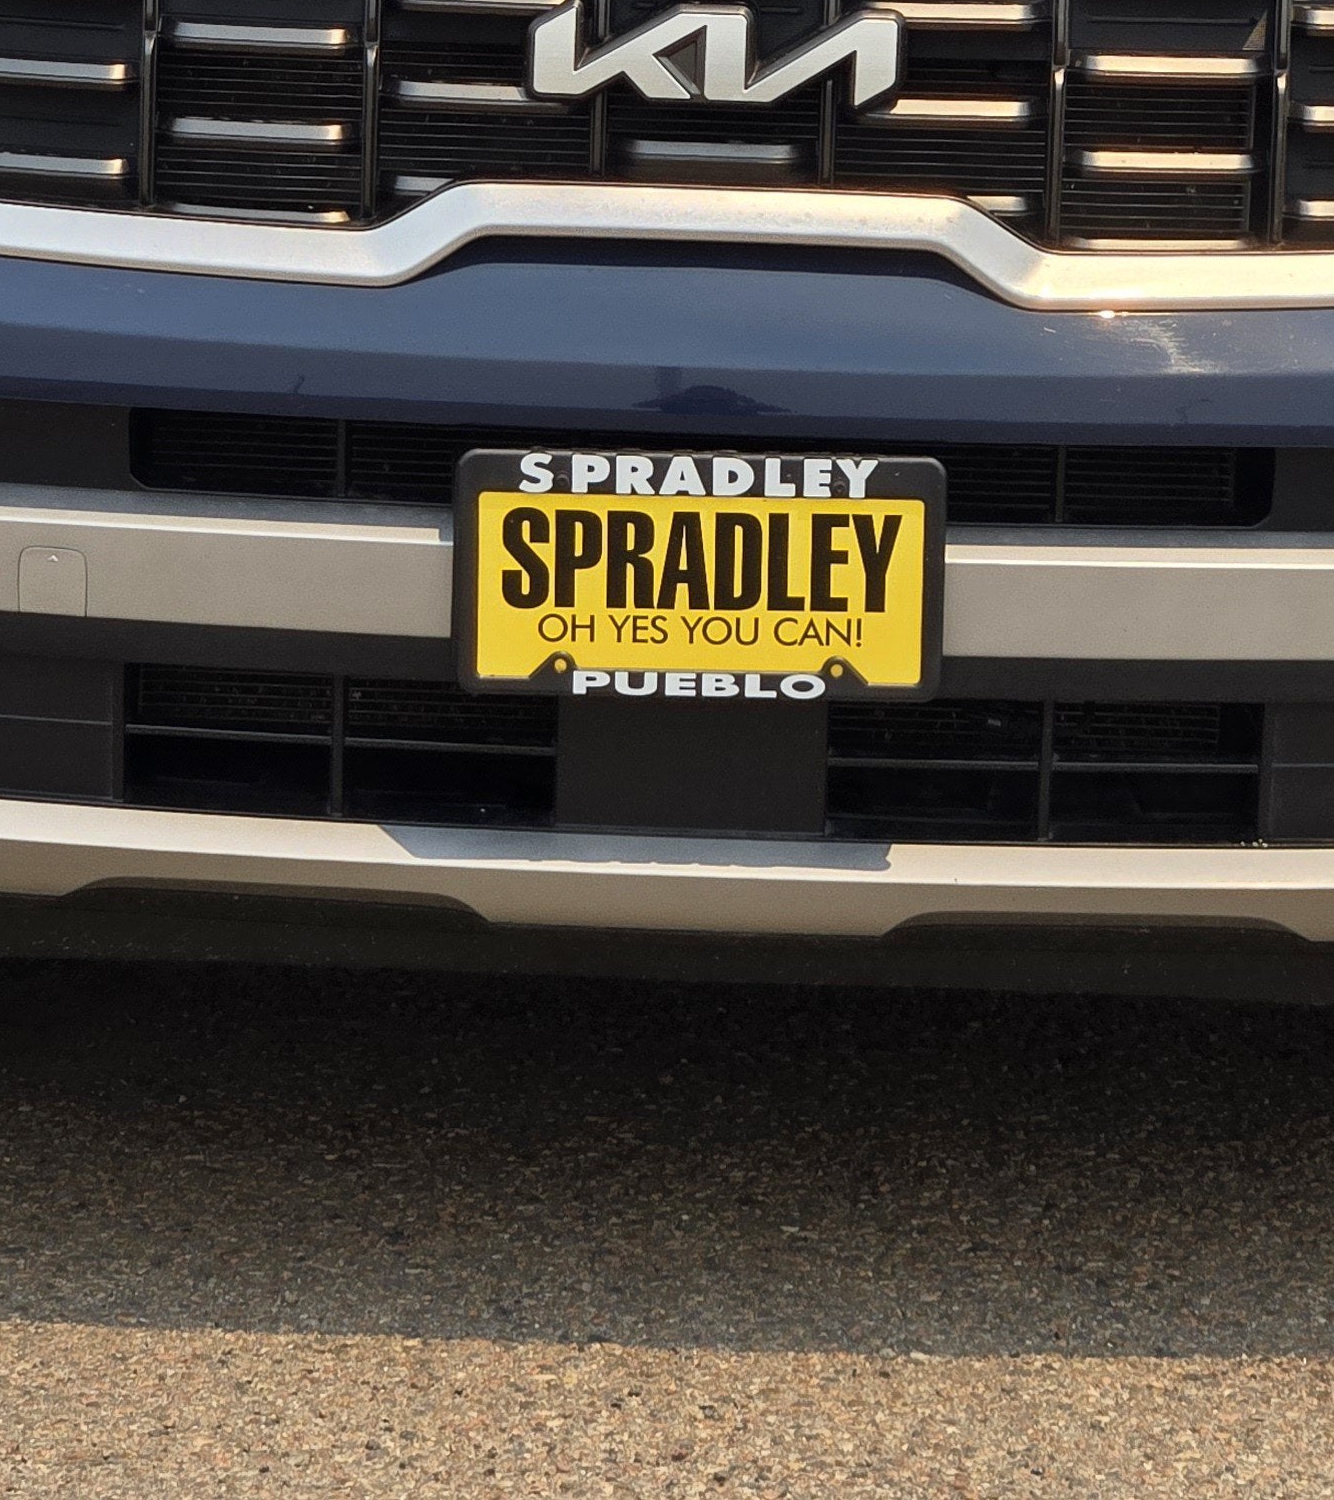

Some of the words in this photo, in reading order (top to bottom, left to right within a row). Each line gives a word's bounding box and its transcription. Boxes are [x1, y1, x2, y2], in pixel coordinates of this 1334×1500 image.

[530, 0, 901, 108] KIA
[501, 506, 902, 613] SPRADLEY
[537, 613, 596, 644] OH
[608, 614, 668, 644] YES
[685, 615, 759, 646] YOU
[773, 617, 862, 647] CAN!
[572, 671, 825, 699] PUEBLO
